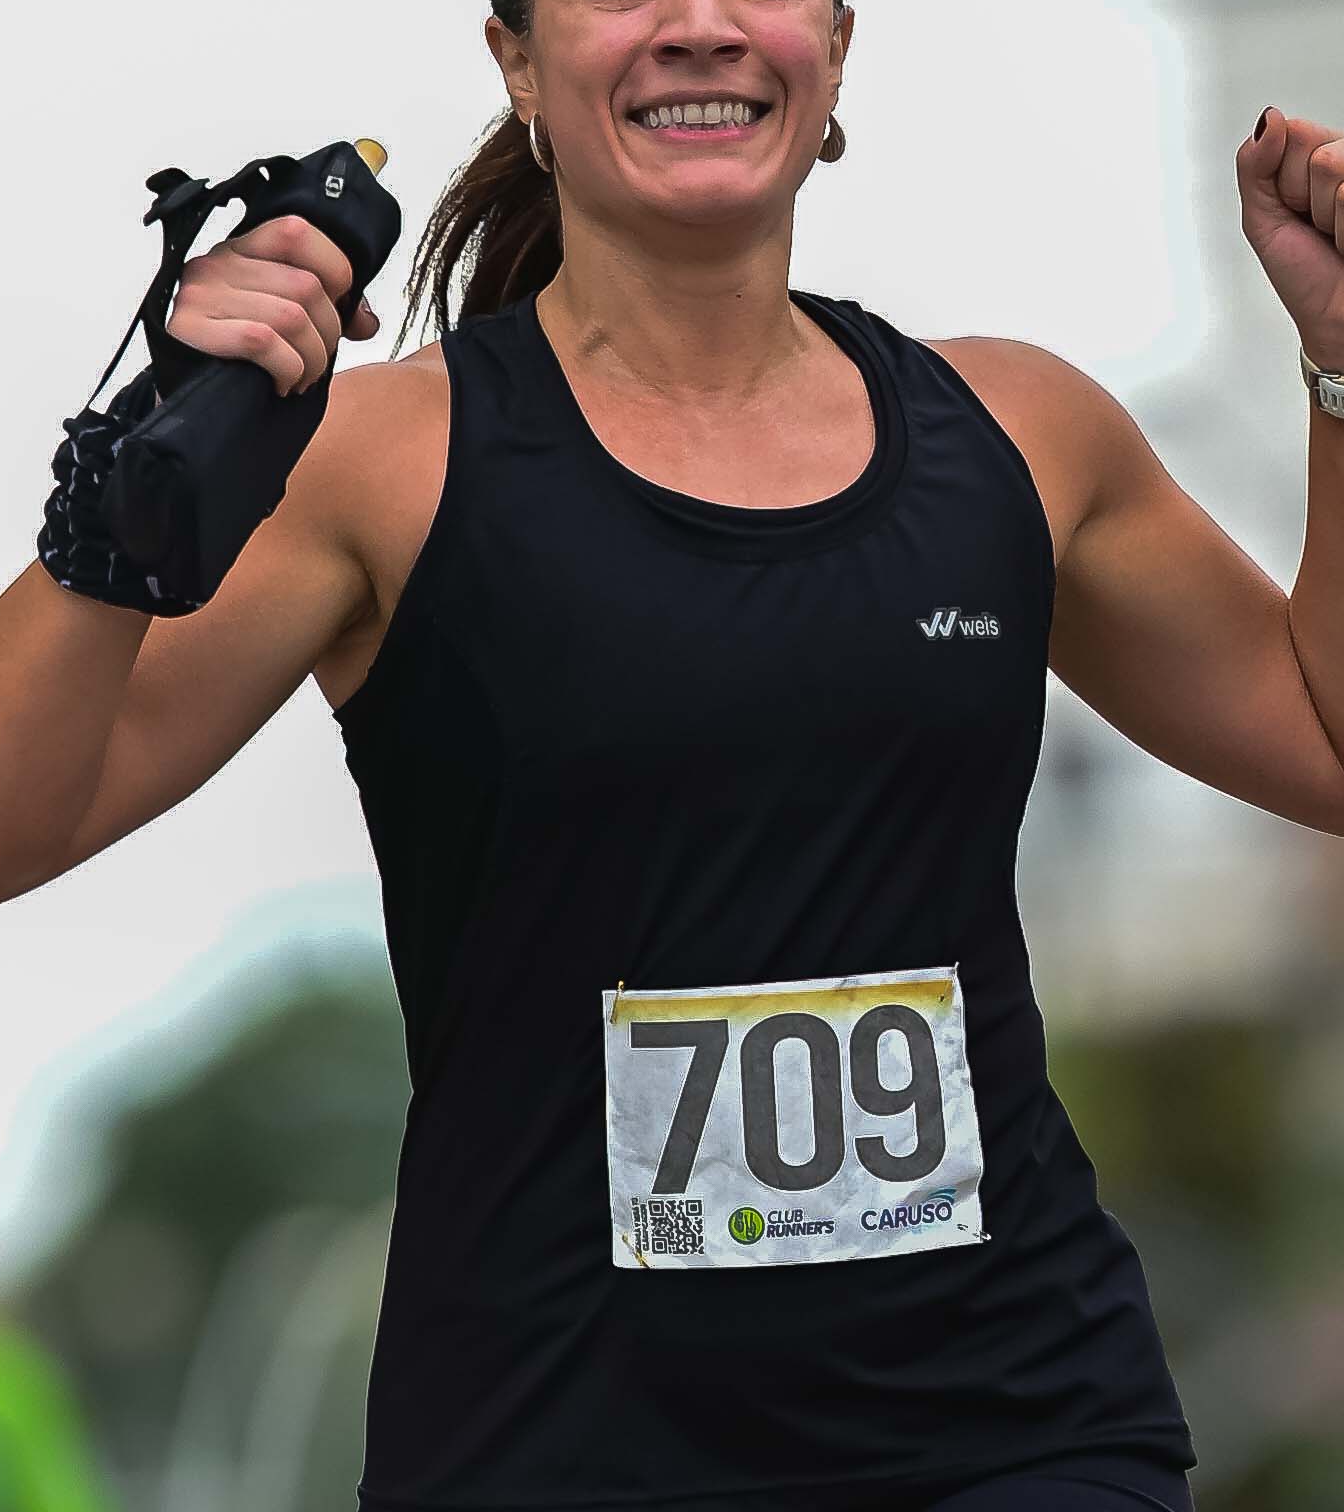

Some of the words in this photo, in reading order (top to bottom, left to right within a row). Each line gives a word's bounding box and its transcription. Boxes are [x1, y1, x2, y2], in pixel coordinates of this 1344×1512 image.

[959, 616, 999, 636] weis
[630, 1004, 947, 1195] 709
[767, 1209, 804, 1224] CLUB
[860, 1201, 953, 1231] CARUSO
